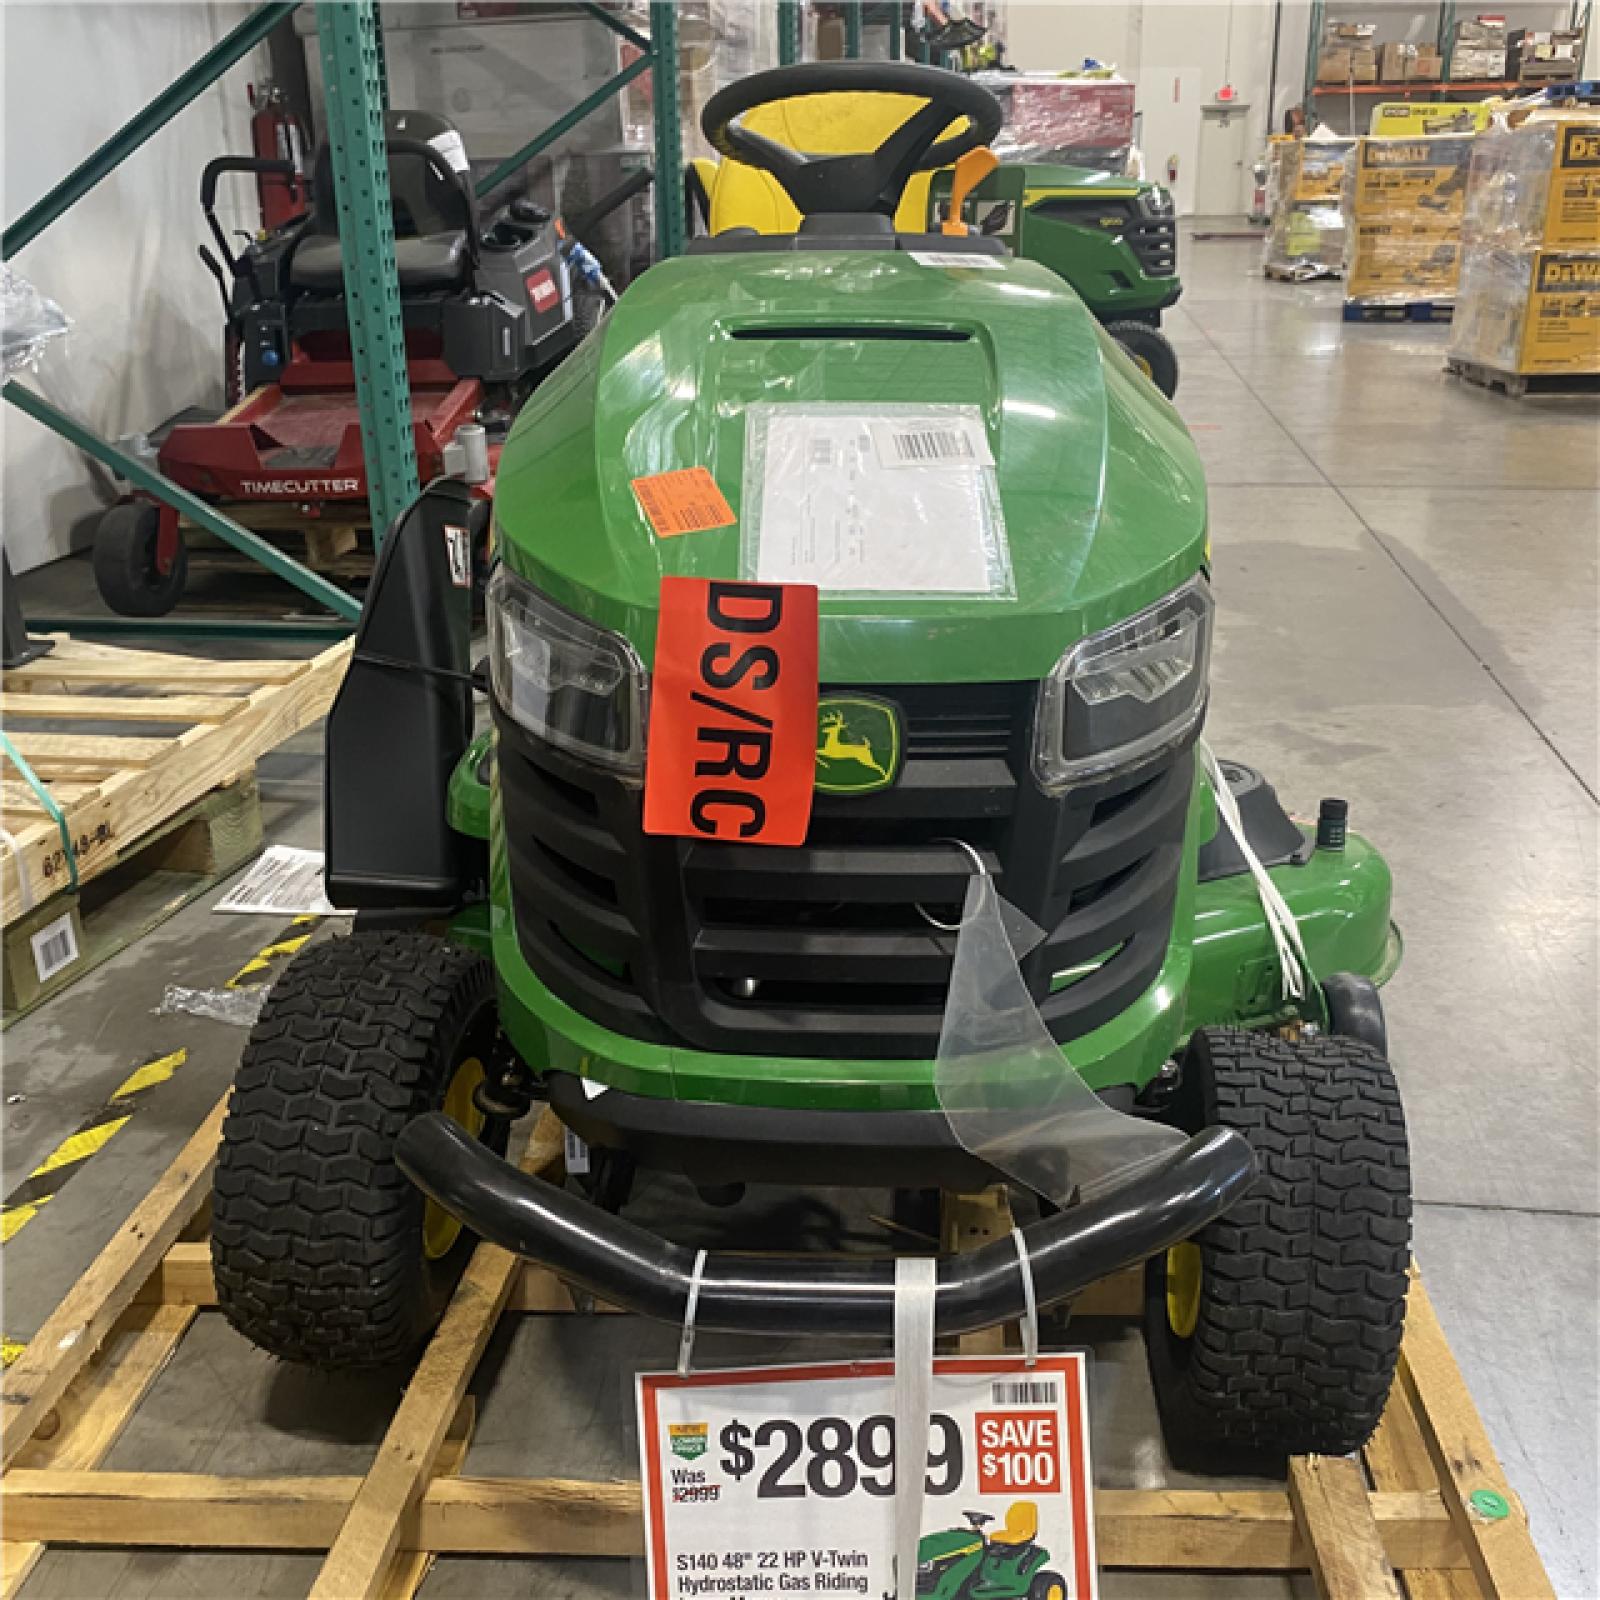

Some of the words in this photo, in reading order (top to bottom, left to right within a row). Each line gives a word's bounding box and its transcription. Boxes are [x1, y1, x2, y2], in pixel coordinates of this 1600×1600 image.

[240, 478, 359, 494] TIMECUTTER
[689, 581, 783, 838] DS/RC
[981, 1419, 1054, 1448] SAVE
[671, 1468, 706, 1483] Was
[981, 1451, 1055, 1486] $100
[677, 1553, 718, 1571] S140
[757, 1551, 779, 1568] 22
[784, 1550, 806, 1568] HP
[811, 1549, 869, 1568] V-Twin
[677, 1574, 774, 1596] Hydrostatic
[779, 1574, 811, 1591] Gas
[815, 1572, 869, 1593] Riding
